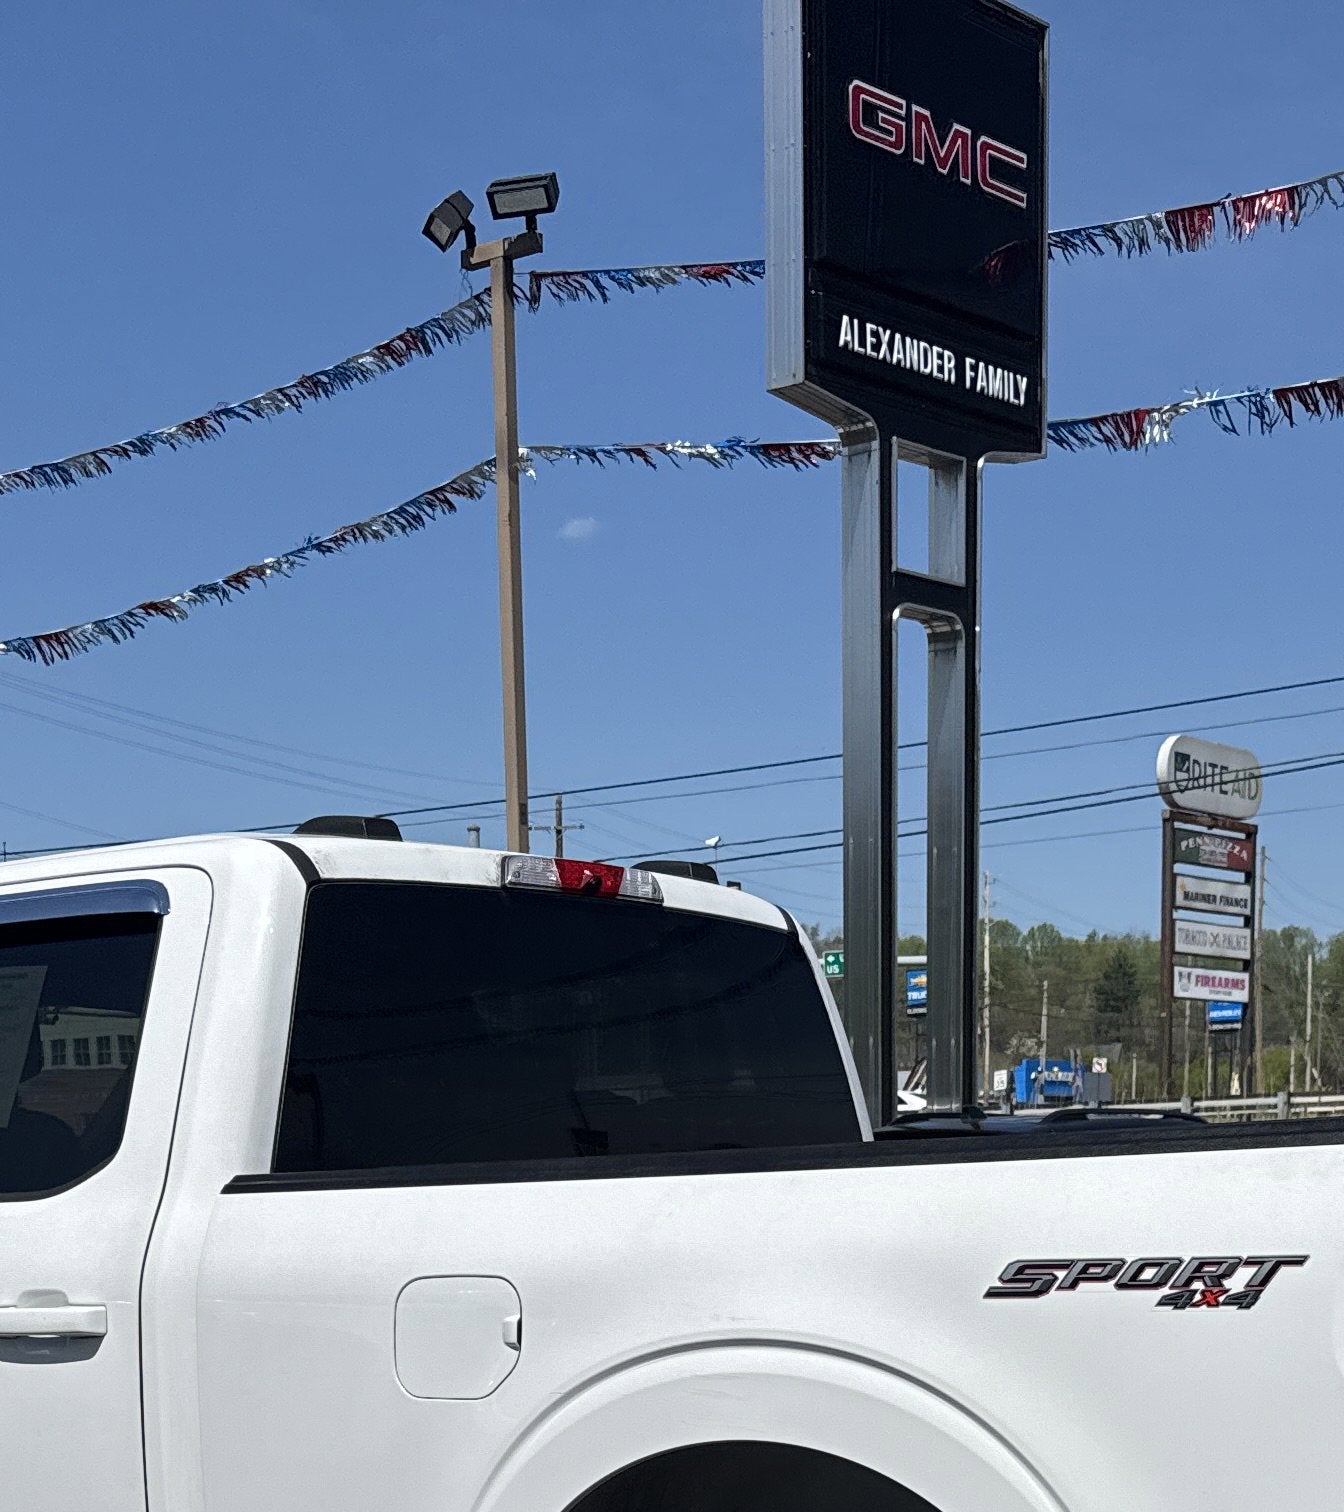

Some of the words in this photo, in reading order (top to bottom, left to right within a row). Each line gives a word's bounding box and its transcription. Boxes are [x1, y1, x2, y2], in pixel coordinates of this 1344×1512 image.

[849, 79, 1027, 208] GMC
[838, 314, 955, 384] ALEXANDER
[965, 357, 1027, 407] FAMILY
[1193, 759, 1229, 795] RITE
[1231, 771, 1258, 801] AID
[1183, 889, 1217, 905] MARINER
[1219, 895, 1248, 909] FINANCE
[826, 964, 840, 974] US
[1195, 974, 1246, 991] FIREARMS
[982, 1254, 1310, 1299] SPORT
